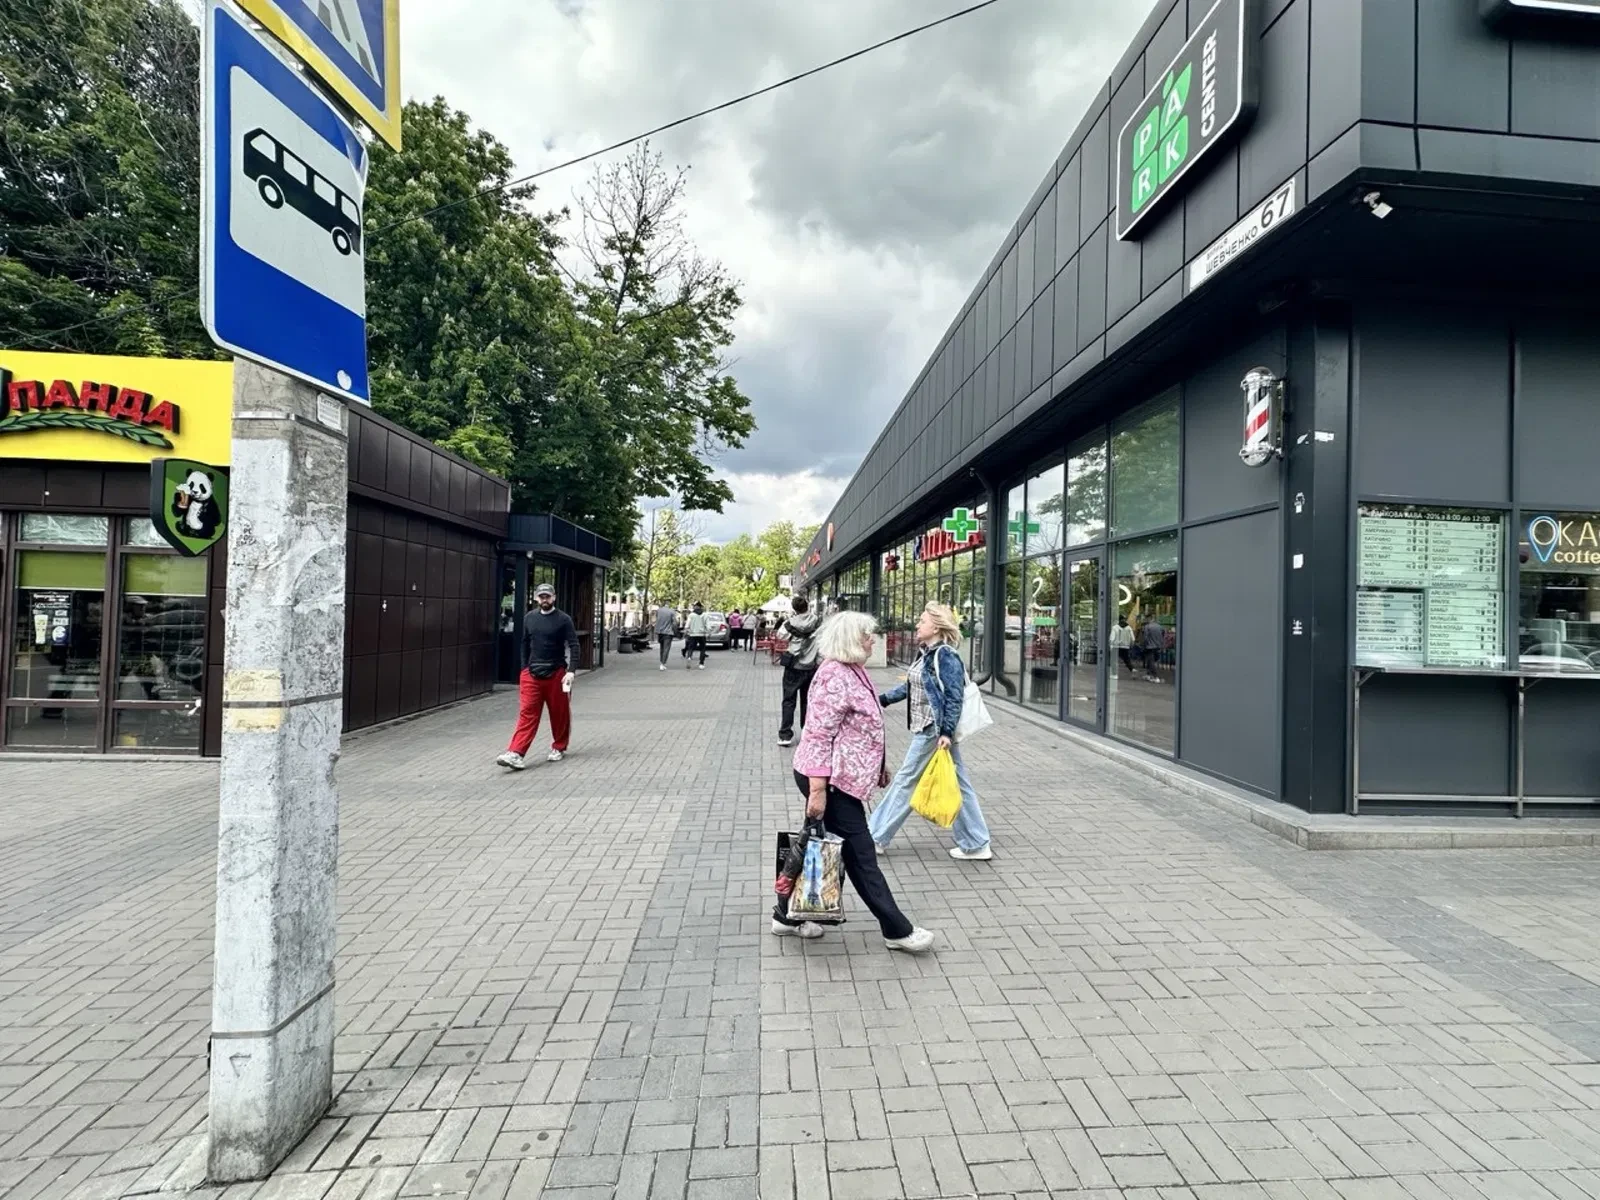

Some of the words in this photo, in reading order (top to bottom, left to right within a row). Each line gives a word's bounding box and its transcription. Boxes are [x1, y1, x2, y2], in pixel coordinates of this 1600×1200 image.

[1201, 28, 1217, 137] CENTER
[1206, 226, 1258, 274] ШЕВЧЕНКО
[1261, 187, 1290, 229] 67
[8, 379, 177, 432] ПАНДА
[1531, 519, 1600, 547] OKA
